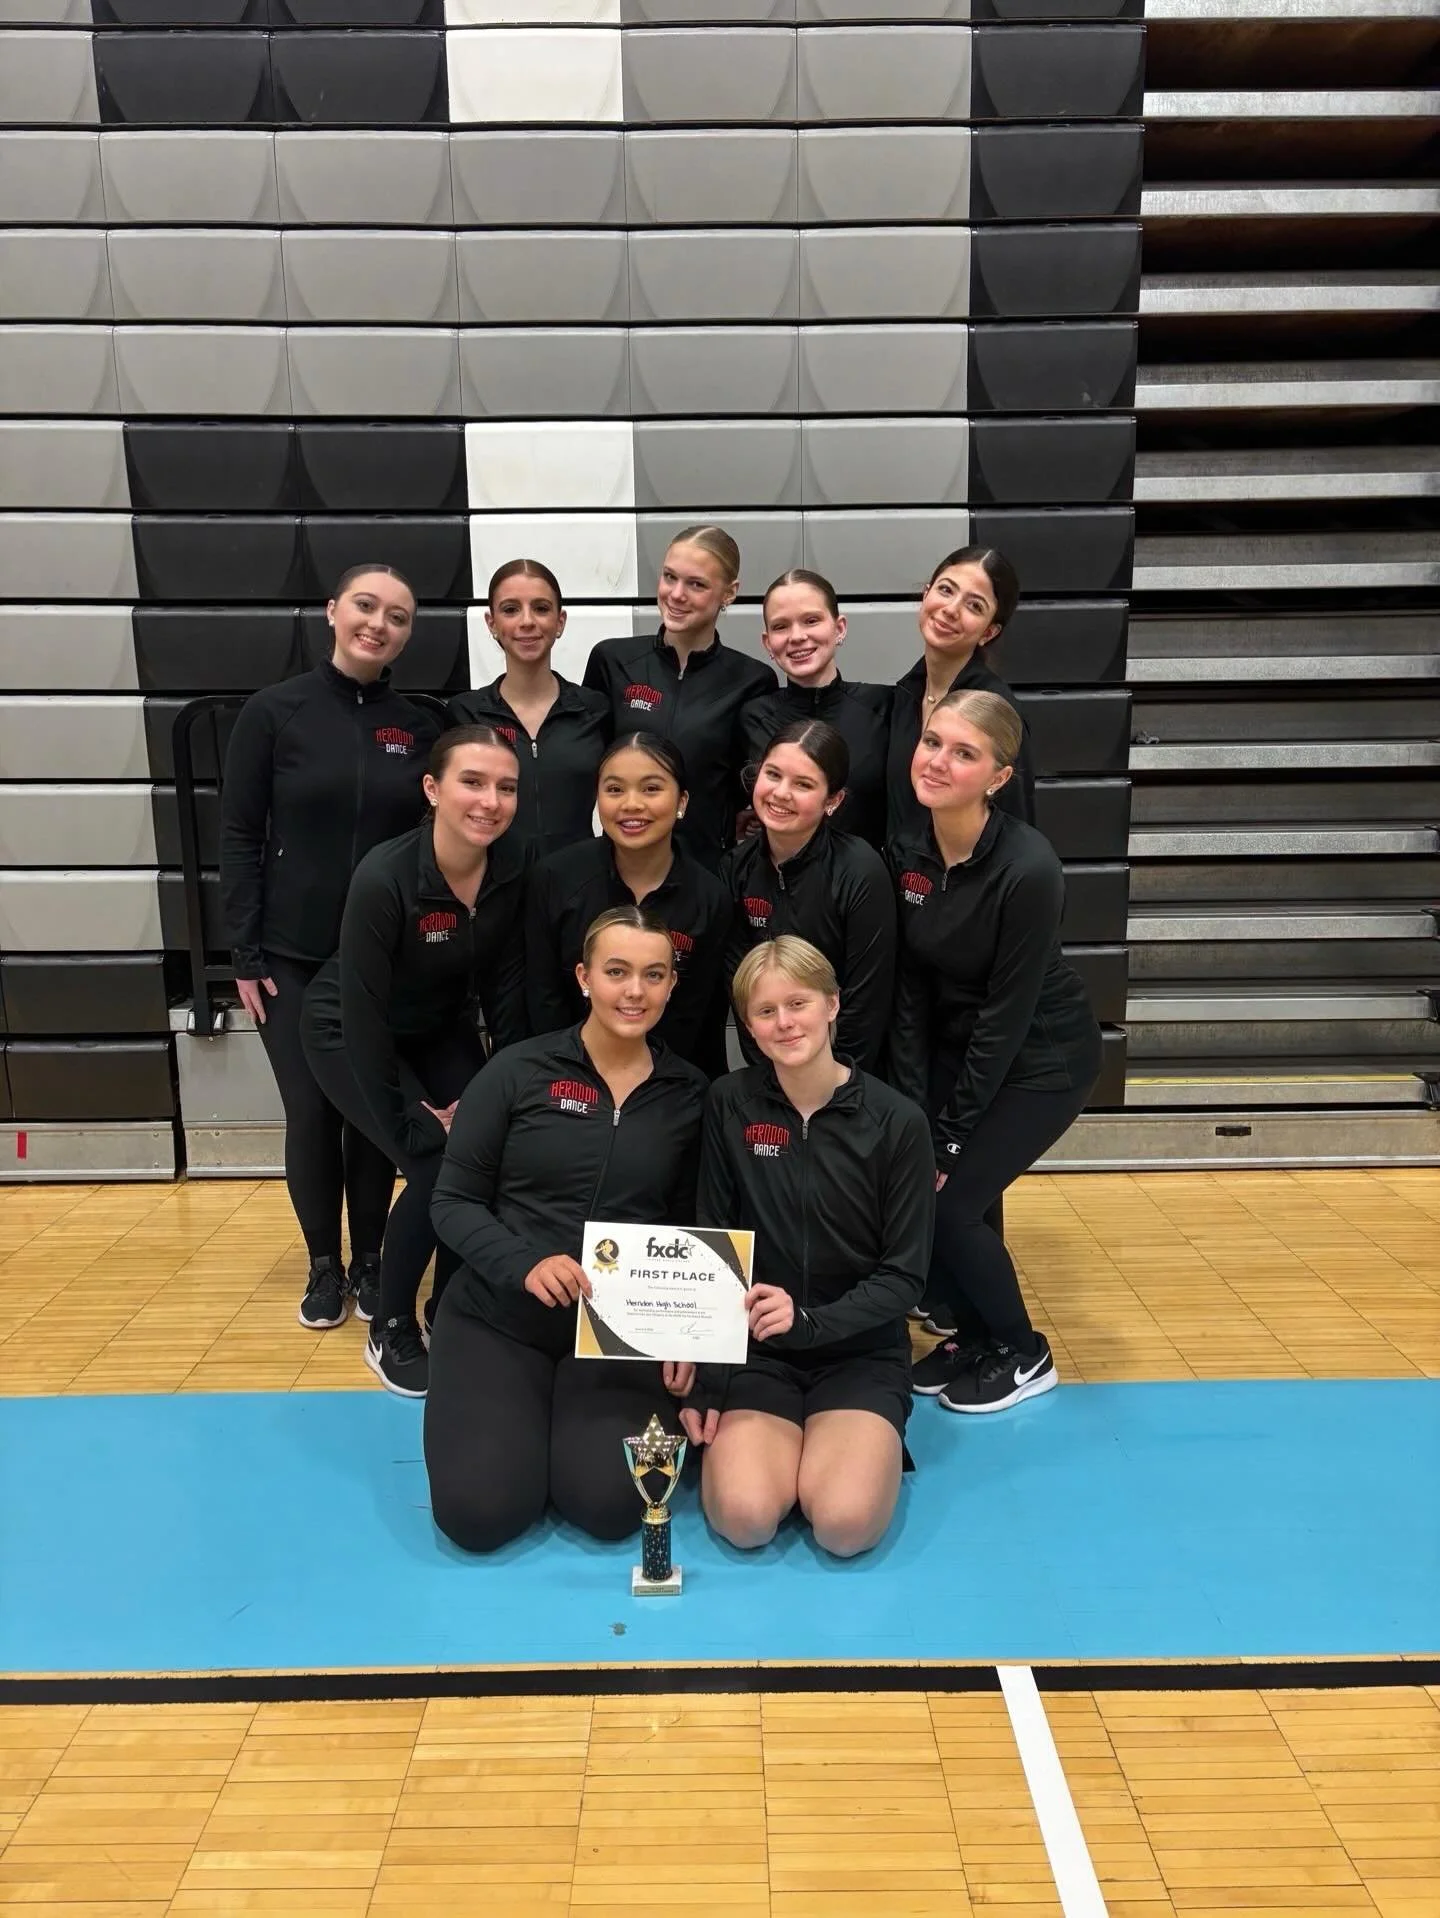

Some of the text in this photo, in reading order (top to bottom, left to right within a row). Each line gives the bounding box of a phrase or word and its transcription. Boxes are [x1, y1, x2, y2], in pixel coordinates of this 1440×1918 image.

[630, 699, 652, 711] DANCE
[376, 727, 415, 746] HERNDON
[385, 743, 408, 755] DANCE
[904, 889, 925, 906] DANCE
[425, 929, 450, 943] DANCE
[551, 1080, 599, 1104] HERNDON
[560, 1098, 588, 1114] DANCE
[745, 1123, 790, 1148] HERNDON
[754, 1143, 781, 1157] DANCE
[646, 1236, 689, 1260] fxdc
[630, 1269, 716, 1282] FIRST PLACE
[655, 1300, 671, 1310] High
[673, 1301, 697, 1310] School
